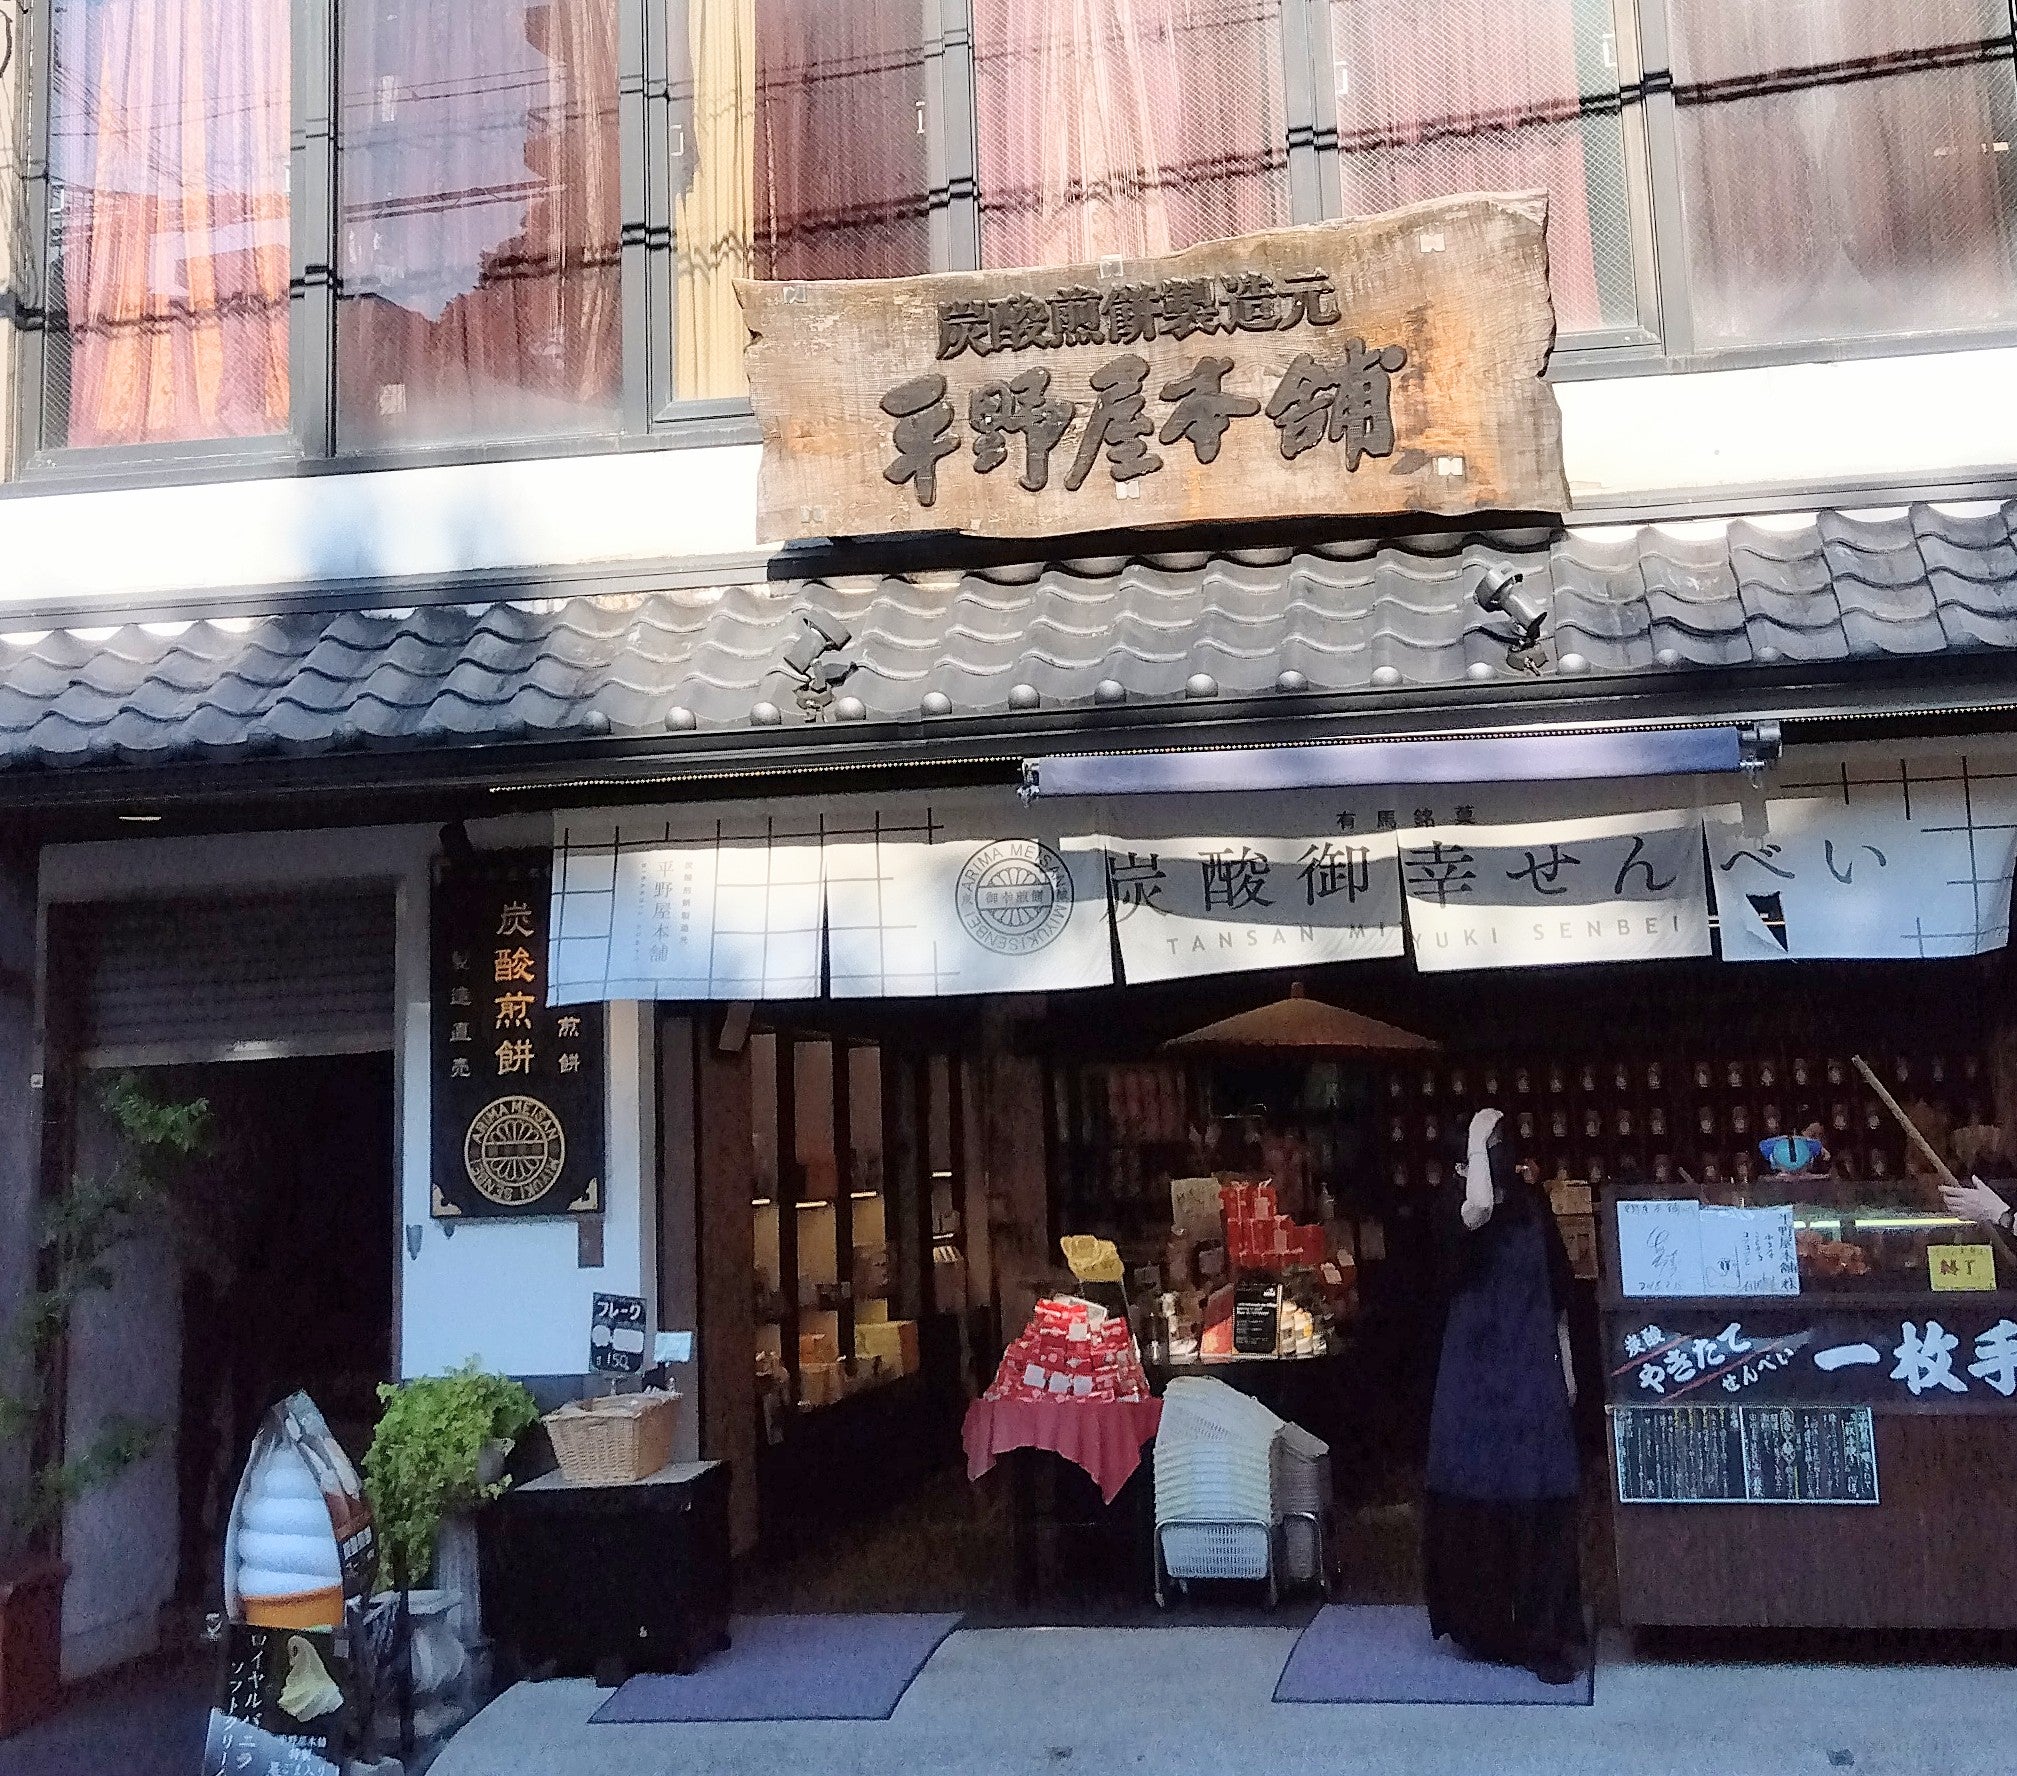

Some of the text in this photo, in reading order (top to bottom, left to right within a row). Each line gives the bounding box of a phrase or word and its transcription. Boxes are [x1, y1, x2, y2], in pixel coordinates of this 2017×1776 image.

[935, 268, 1342, 360] 炭酸煎餅製造元
[880, 337, 1408, 508] 平野屋本舗
[962, 846, 1004, 892] ARIMA
[1100, 836, 1888, 922] 炭酸御幸せんべい
[1166, 915, 1679, 955] TANSAN MIYUKI SENBEI
[494, 900, 536, 1077] 炭酸煎餅
[597, 1301, 641, 1321] フレーク
[1638, 1322, 1752, 1394] やきたて
[1722, 1347, 1795, 1392] せんべい
